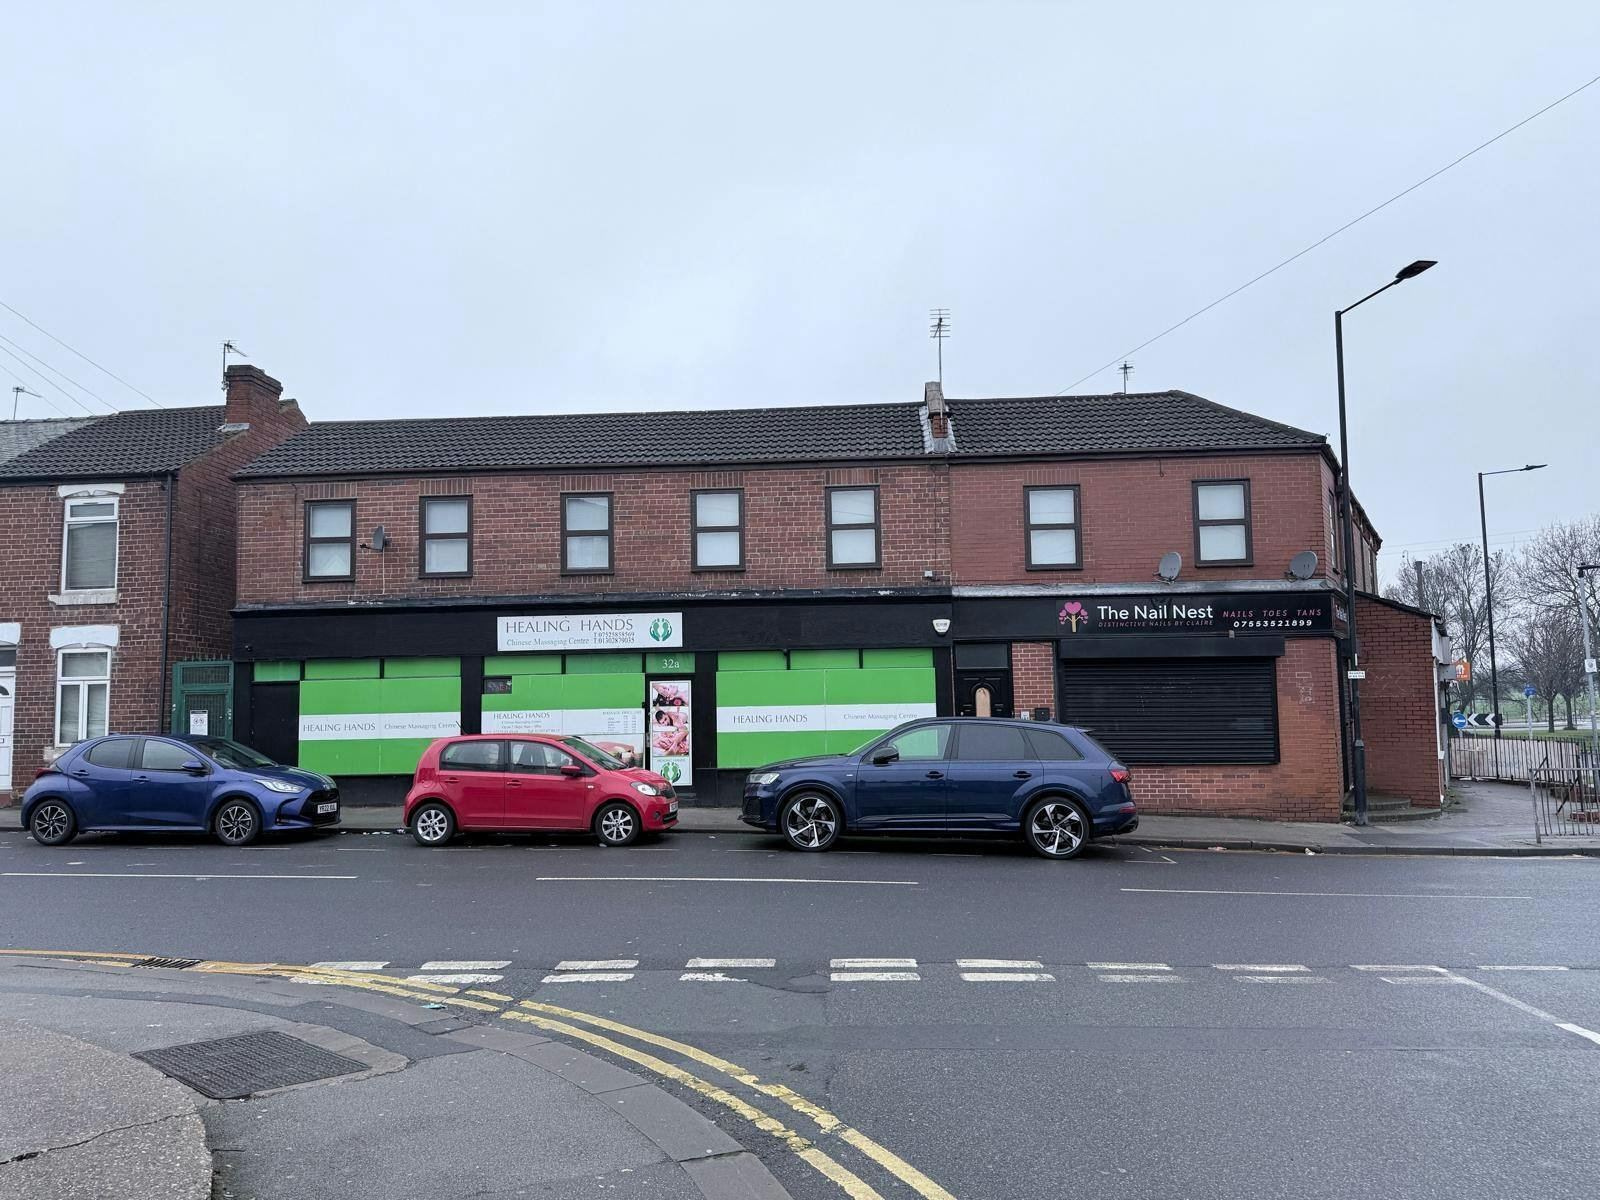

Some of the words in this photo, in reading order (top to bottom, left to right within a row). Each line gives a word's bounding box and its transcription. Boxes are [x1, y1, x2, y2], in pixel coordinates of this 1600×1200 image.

[1097, 605, 1129, 620] The
[1134, 604, 1167, 619] Nail
[1173, 604, 1213, 619] Nest
[1222, 610, 1254, 618] NAILS
[1263, 609, 1288, 617] TOES
[1297, 608, 1322, 617] TANS
[506, 619, 571, 633] HEALING
[580, 618, 634, 632] HANDS
[506, 638, 532, 646] Chinese
[533, 638, 568, 647] Massaging
[568, 637, 590, 645] Centre
[662, 659, 680, 669] 32a
[493, 712, 523, 720] HEALING
[526, 711, 551, 719] HANDS
[733, 714, 773, 724] HEALING
[775, 714, 808, 723] HANDS
[898, 712, 918, 720] Centre
[303, 723, 341, 732] HEALING
[344, 722, 376, 731] HANDS
